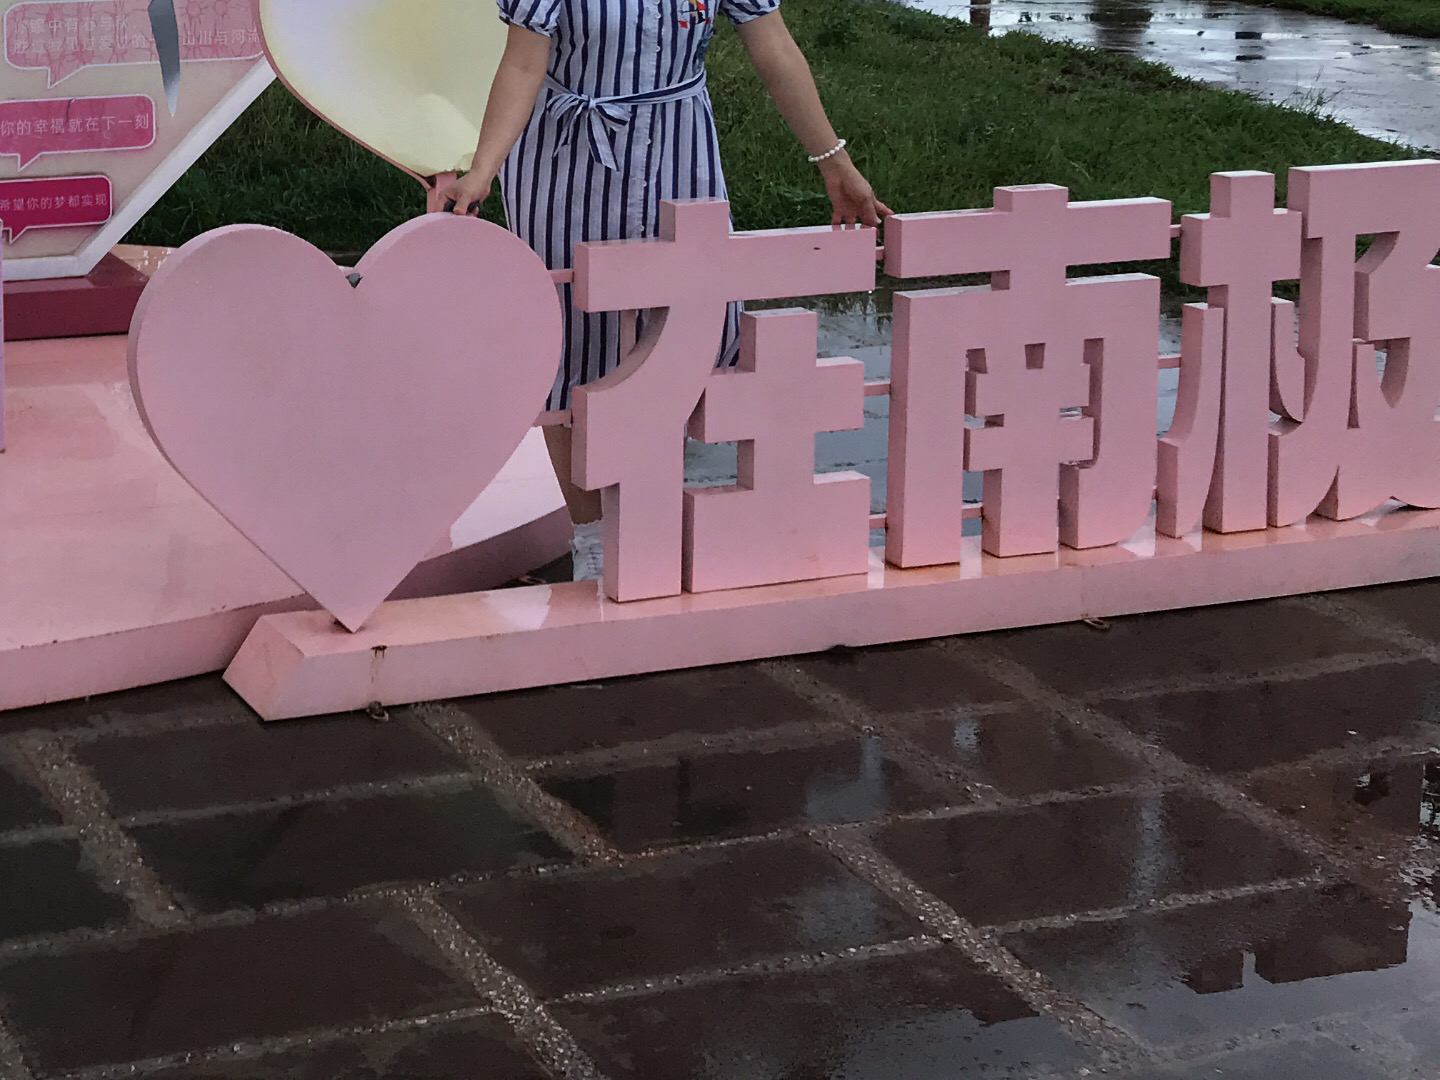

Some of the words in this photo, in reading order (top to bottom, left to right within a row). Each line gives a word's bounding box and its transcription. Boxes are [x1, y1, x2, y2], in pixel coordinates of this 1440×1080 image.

[0, 113, 150, 137] 你的幸福就在下一刻
[0, 193, 107, 211] 希望你的梦都实现
